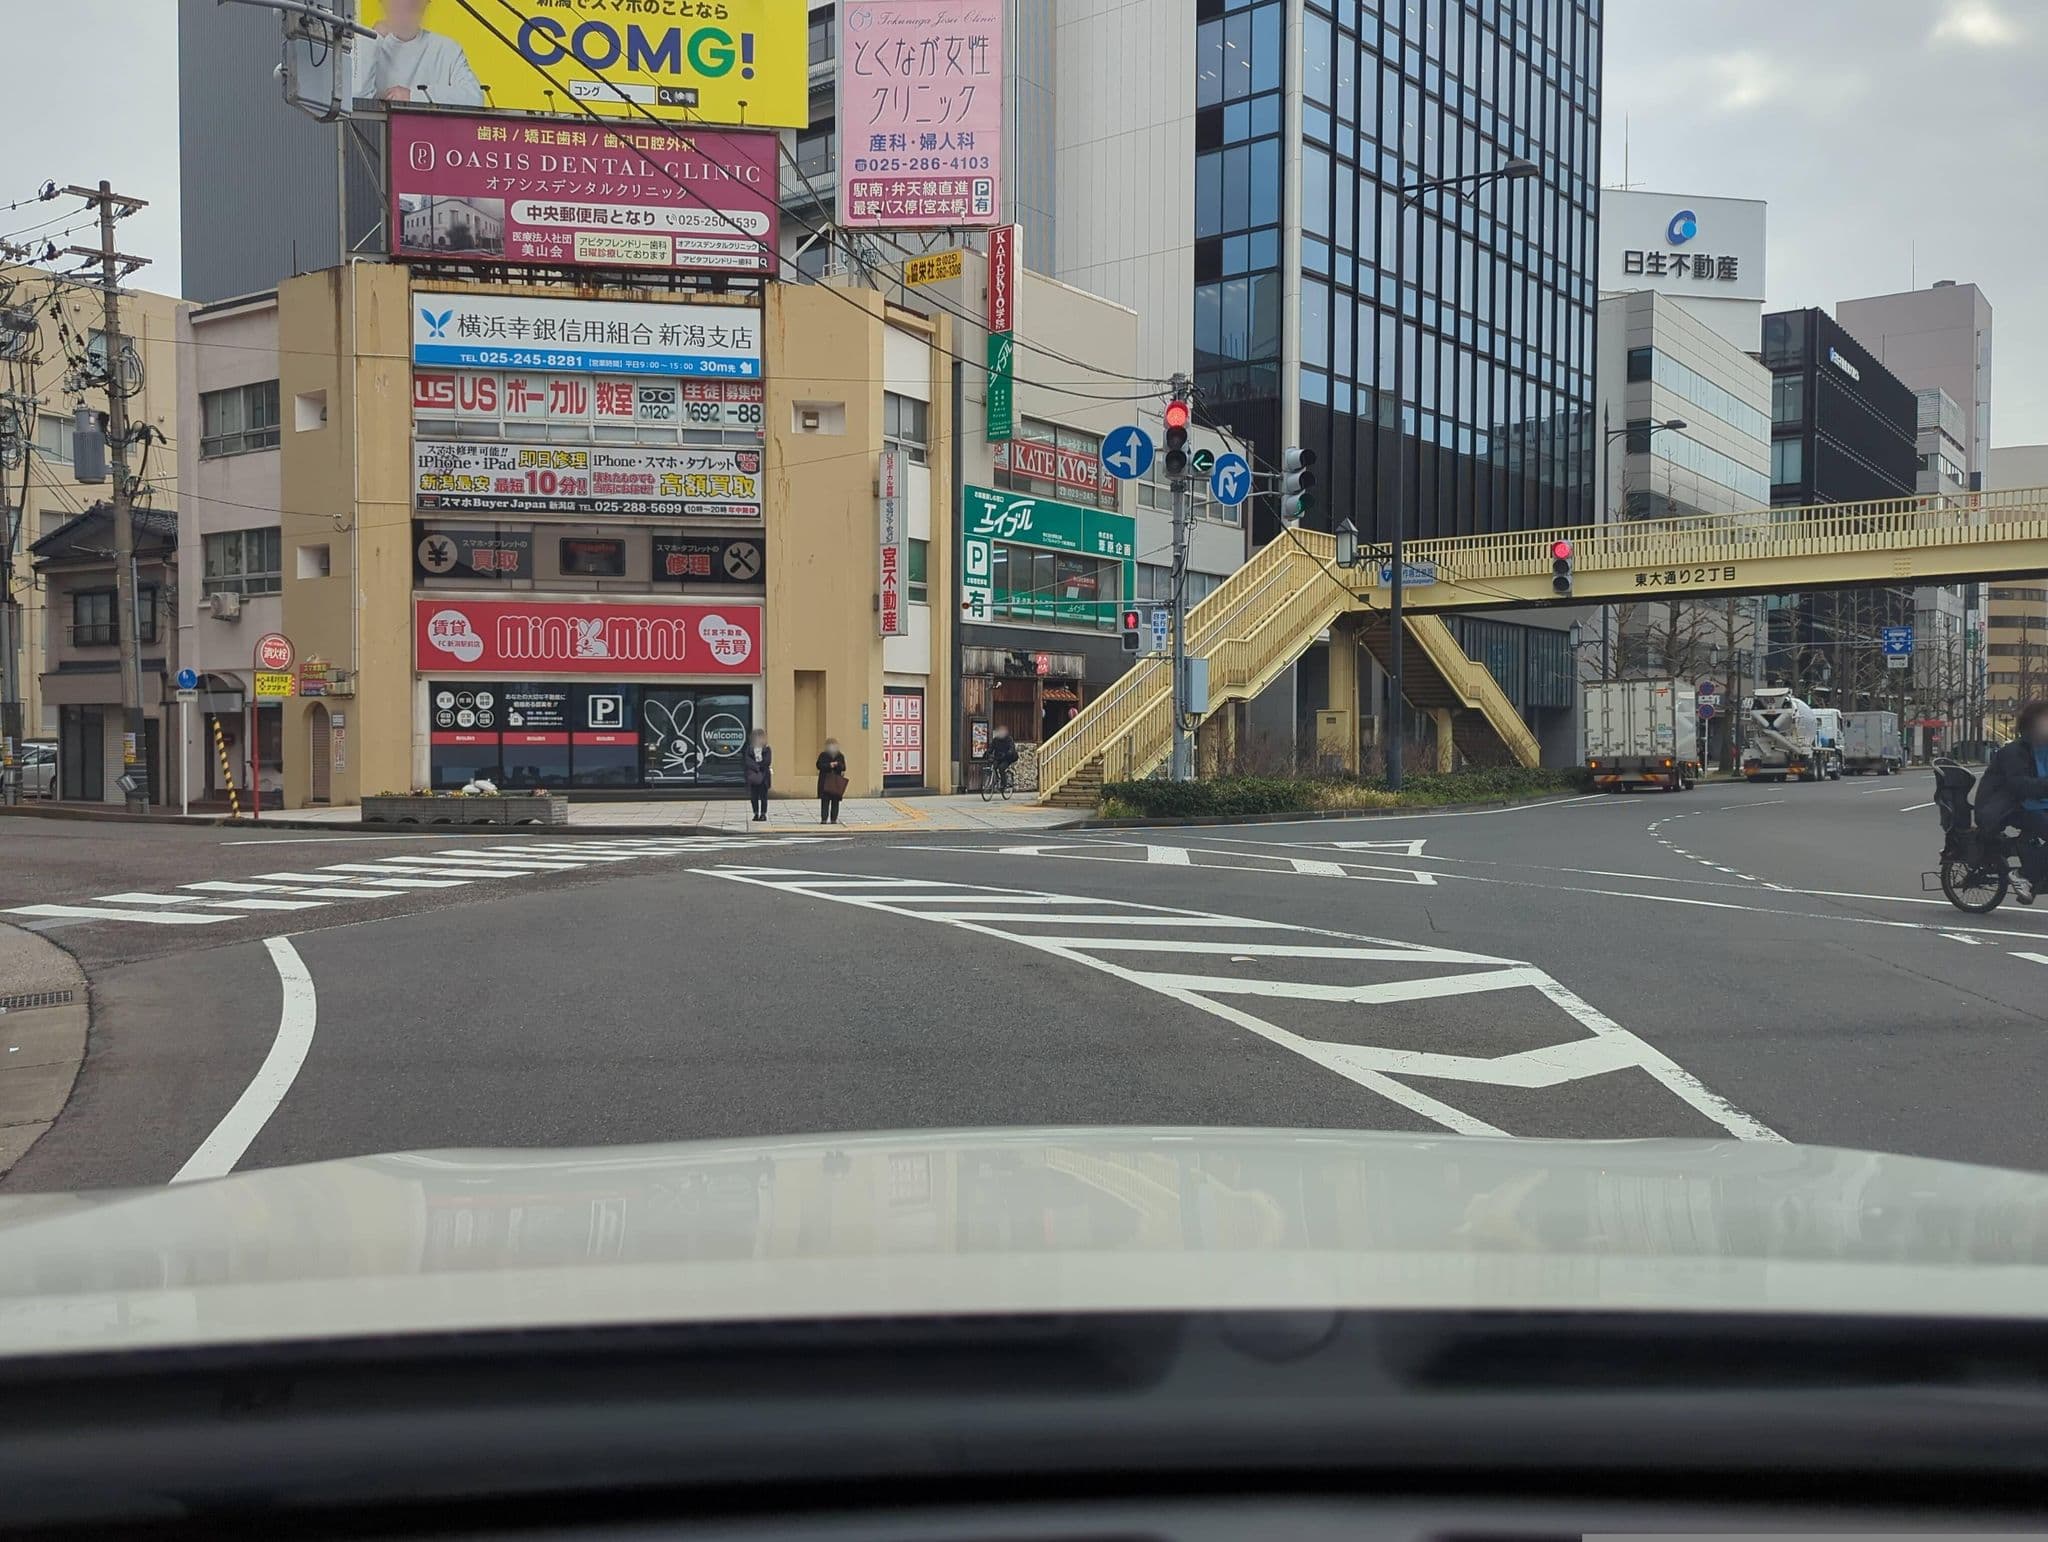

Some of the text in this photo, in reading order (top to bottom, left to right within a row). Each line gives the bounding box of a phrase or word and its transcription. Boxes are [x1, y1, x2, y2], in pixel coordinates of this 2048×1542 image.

[518, 16, 755, 79] COMG!
[855, 35, 990, 77] とくなが女性
[574, 86, 600, 97] コング
[869, 85, 976, 125] クリニック
[477, 126, 507, 142] 歯科
[525, 129, 587, 146] 矯正歯科
[604, 134, 696, 152] 歯科口腔外科
[869, 131, 975, 153] 産科・婦人科
[446, 150, 760, 183] OASIS DENTAL CLINIC
[869, 157, 990, 171] 025-286-4103
[486, 177, 688, 200] オアシスデンタルクリニック
[853, 180, 969, 197] 駅南・弁天線直進
[527, 205, 655, 226] 中央郵便局となり
[512, 232, 572, 245] 医療法人社団
[678, 241, 758, 250] オアシスデンタルクリニック
[522, 244, 563, 258] 美山会
[1624, 250, 1738, 281] 日生不動産
[457, 313, 753, 350] 横浜幸銀信用組合 新潟支店
[461, 354, 478, 363] TEL
[480, 352, 582, 367] 025-245-8281
[519, 450, 588, 469] 即日修理
[420, 473, 490, 492] 新潟最安
[659, 473, 756, 498] 高額買取
[595, 502, 682, 514] 025-288-5699
[472, 548, 519, 572] 買取
[666, 553, 711, 575] 修理
[972, 547, 983, 570] P
[1634, 566, 1737, 587] 東大通り2丁目
[882, 547, 897, 632] 宮不動産
[969, 590, 986, 618] 有
[432, 619, 466, 636] 賃貸
[497, 616, 686, 660] mini mini
[715, 639, 747, 655] 売買
[597, 699, 615, 720] P
[704, 731, 743, 740] Welcome
